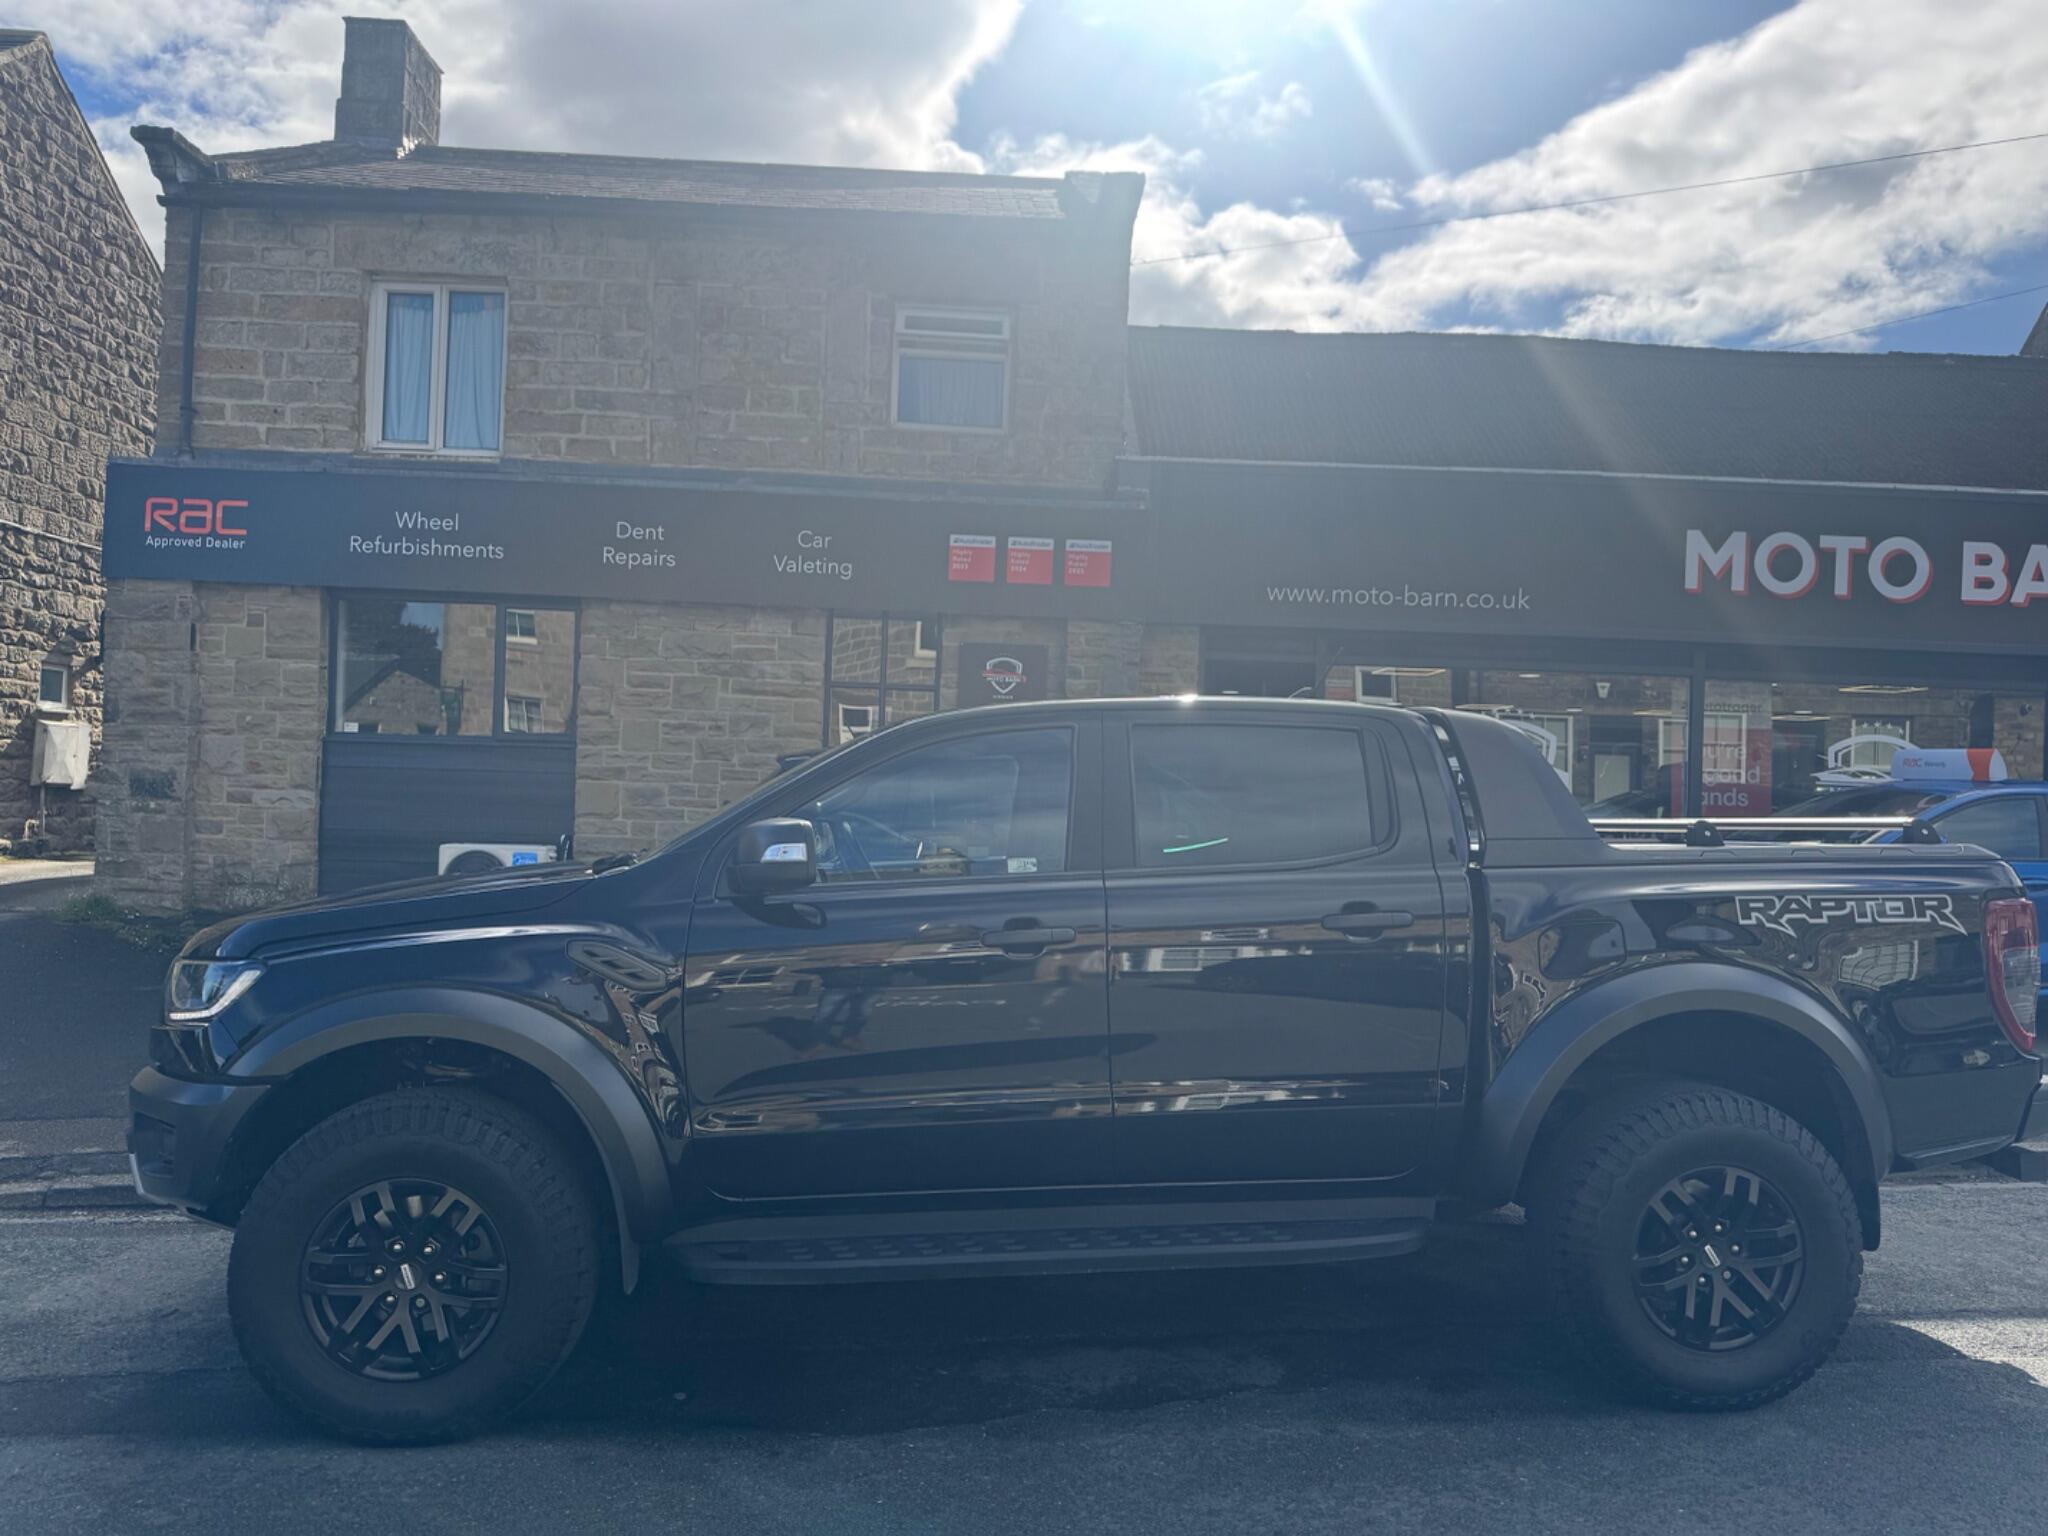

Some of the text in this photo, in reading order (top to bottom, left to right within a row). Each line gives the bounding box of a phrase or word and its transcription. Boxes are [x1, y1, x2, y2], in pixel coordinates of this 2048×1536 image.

[395, 511, 460, 532] Wheel
[616, 521, 664, 542] Dent
[145, 535, 245, 550] Approved Dealer
[349, 535, 504, 560] Refurbishments
[797, 530, 832, 549] Car
[602, 546, 676, 569] Repairs
[774, 554, 853, 580] Valeting
[1684, 529, 1932, 603] MOTO
[1266, 584, 1531, 611] www.moto-barn.co.uk
[1702, 788, 1749, 807] ands
[1736, 894, 1967, 936] RAPTOR
